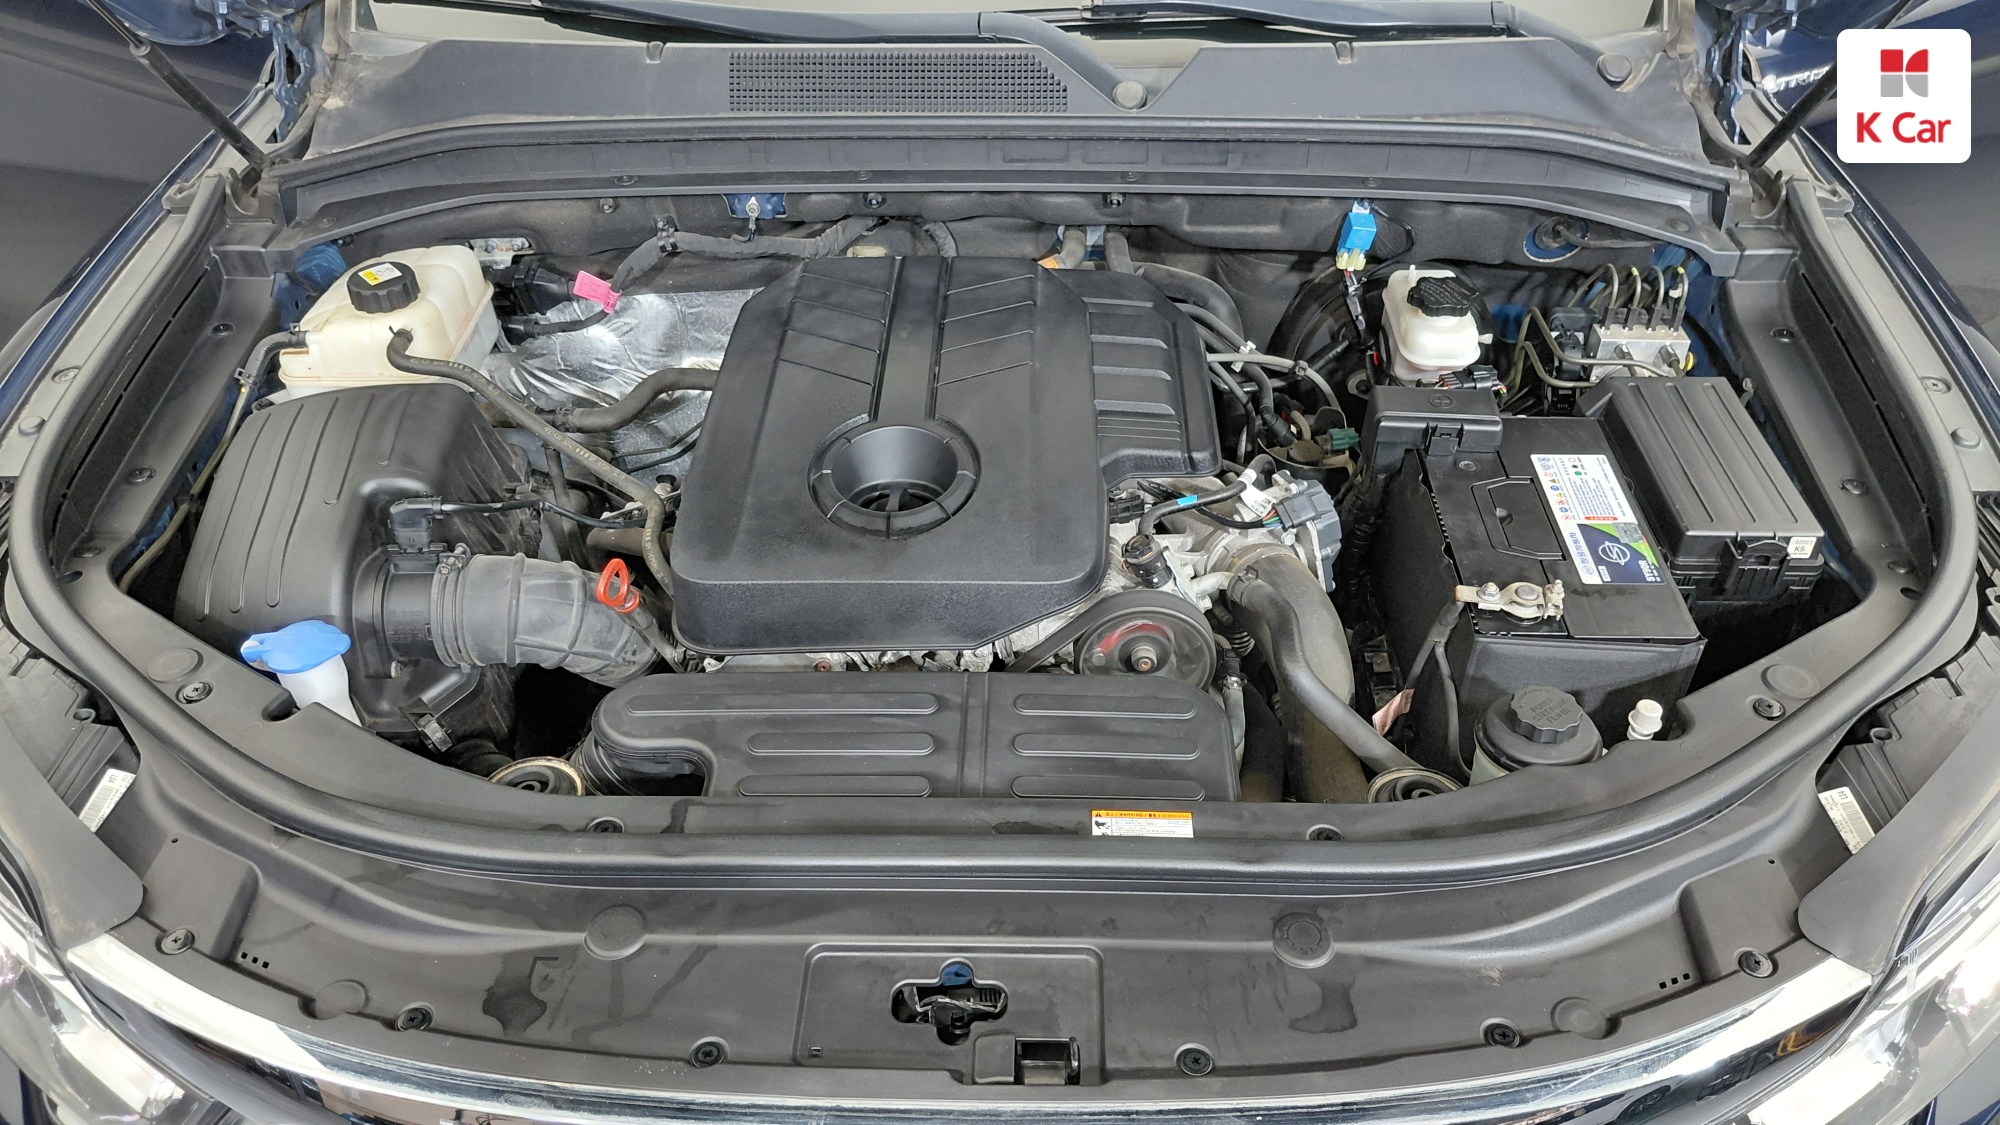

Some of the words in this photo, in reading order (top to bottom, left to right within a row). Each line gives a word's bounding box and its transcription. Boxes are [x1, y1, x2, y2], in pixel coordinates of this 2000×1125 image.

[1638, 559, 1656, 582] SY90R
[1530, 697, 1554, 713] POWER
[1533, 698, 1569, 722] STEERING
[1547, 708, 1571, 724] FLUID
